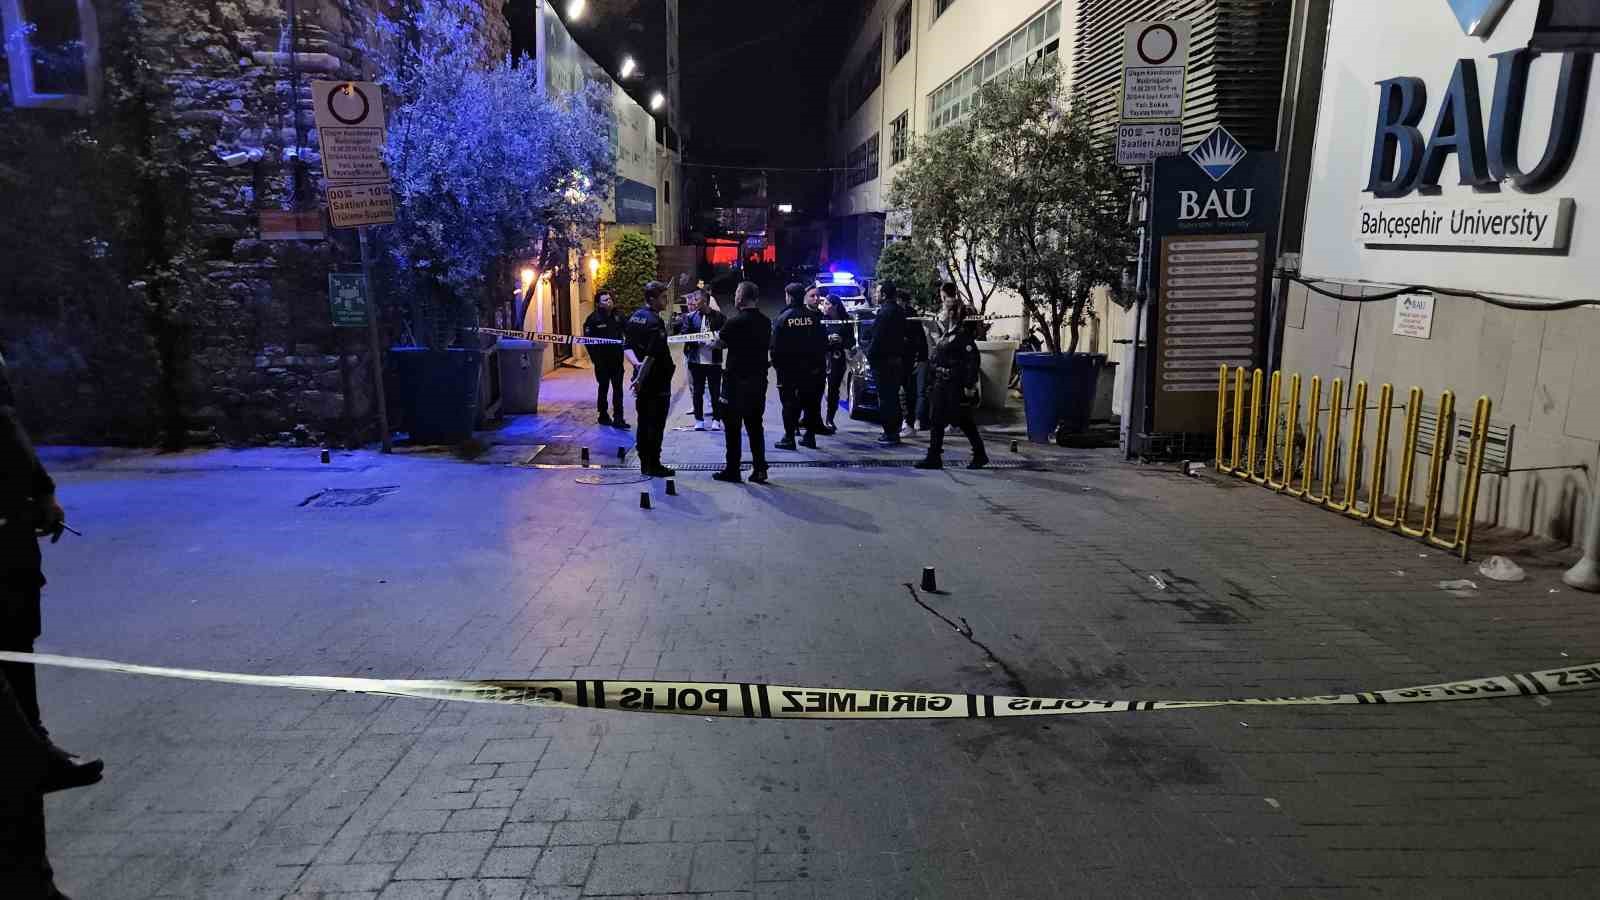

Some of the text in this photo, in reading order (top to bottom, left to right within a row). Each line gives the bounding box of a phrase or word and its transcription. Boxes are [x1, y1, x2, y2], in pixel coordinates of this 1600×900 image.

[1361, 47, 1594, 199] BAU
[1176, 187, 1256, 220] BAU
[1361, 207, 1548, 242] Bahçeşehir University
